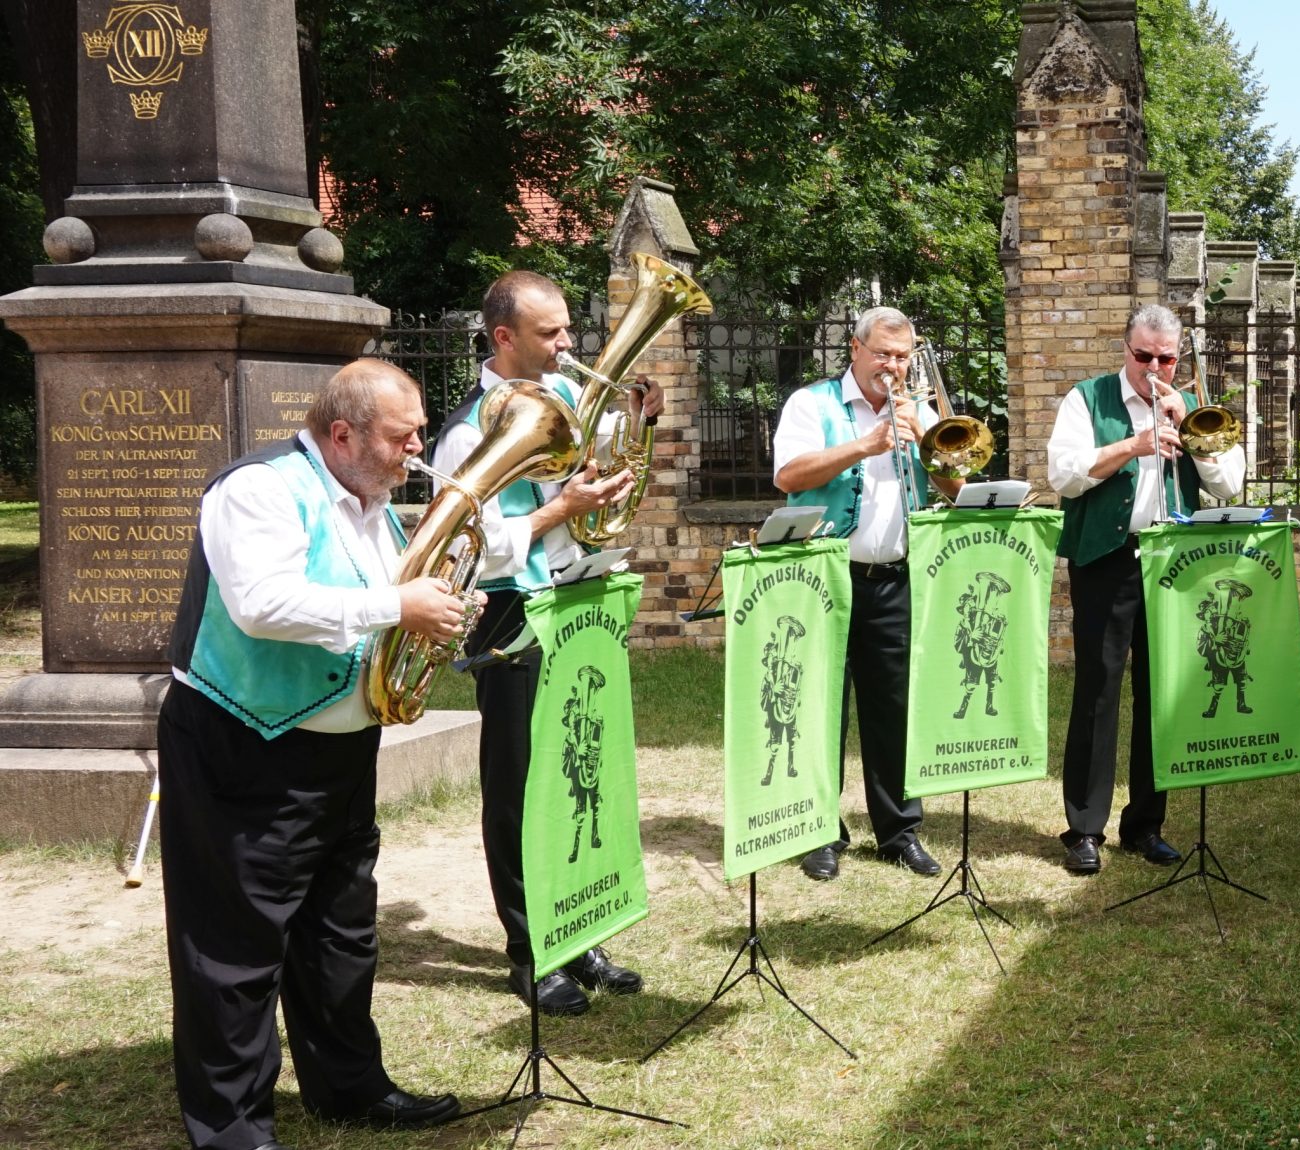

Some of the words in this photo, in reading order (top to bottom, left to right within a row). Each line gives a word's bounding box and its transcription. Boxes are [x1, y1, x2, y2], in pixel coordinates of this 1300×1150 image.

[128, 29, 161, 58] XII
[79, 389, 157, 416] CARL
[159, 388, 191, 415] XII
[271, 391, 300, 403] DIESES
[51, 424, 103, 442] KÖNIG
[129, 424, 222, 442] SCHWEDEN
[75, 450, 99, 461] DER
[102, 450, 114, 460] IN
[118, 448, 198, 461] ALTRANSTÄDT
[183, 469, 208, 479] 1707
[56, 488, 81, 498] SEIN
[85, 488, 178, 499] HAUPTQUARTIER
[61, 507, 111, 517] SCHLOSS
[115, 507, 141, 517] HIER
[144, 507, 192, 517] FRIEDEN
[67, 524, 120, 541] KÖNIG
[126, 526, 198, 541] AUGUST
[92, 550, 111, 560] AM
[926, 528, 1040, 579] Dorfmusikanten
[76, 569, 101, 579] UND
[105, 568, 180, 579] KONVENTION
[1158, 539, 1283, 590] Dorfmusikanten
[68, 586, 133, 604] KAISER
[138, 587, 184, 604] JOSE
[733, 562, 834, 626] Dorfmusikanten
[102, 612, 120, 622] AM
[936, 737, 1019, 756] MUSIKVEREIN
[1187, 732, 1280, 754] MUSIKVEREIN
[919, 757, 1006, 777] ALTRANSTÄDT
[1171, 752, 1268, 774] ALTRANSTÄDT
[748, 798, 814, 830] MUSIKVEREIN
[735, 822, 806, 857] ALTRANSTÄDT
[554, 871, 620, 918] MUSIKVEREIN
[544, 900, 612, 951] ALTRANSTÄDT
